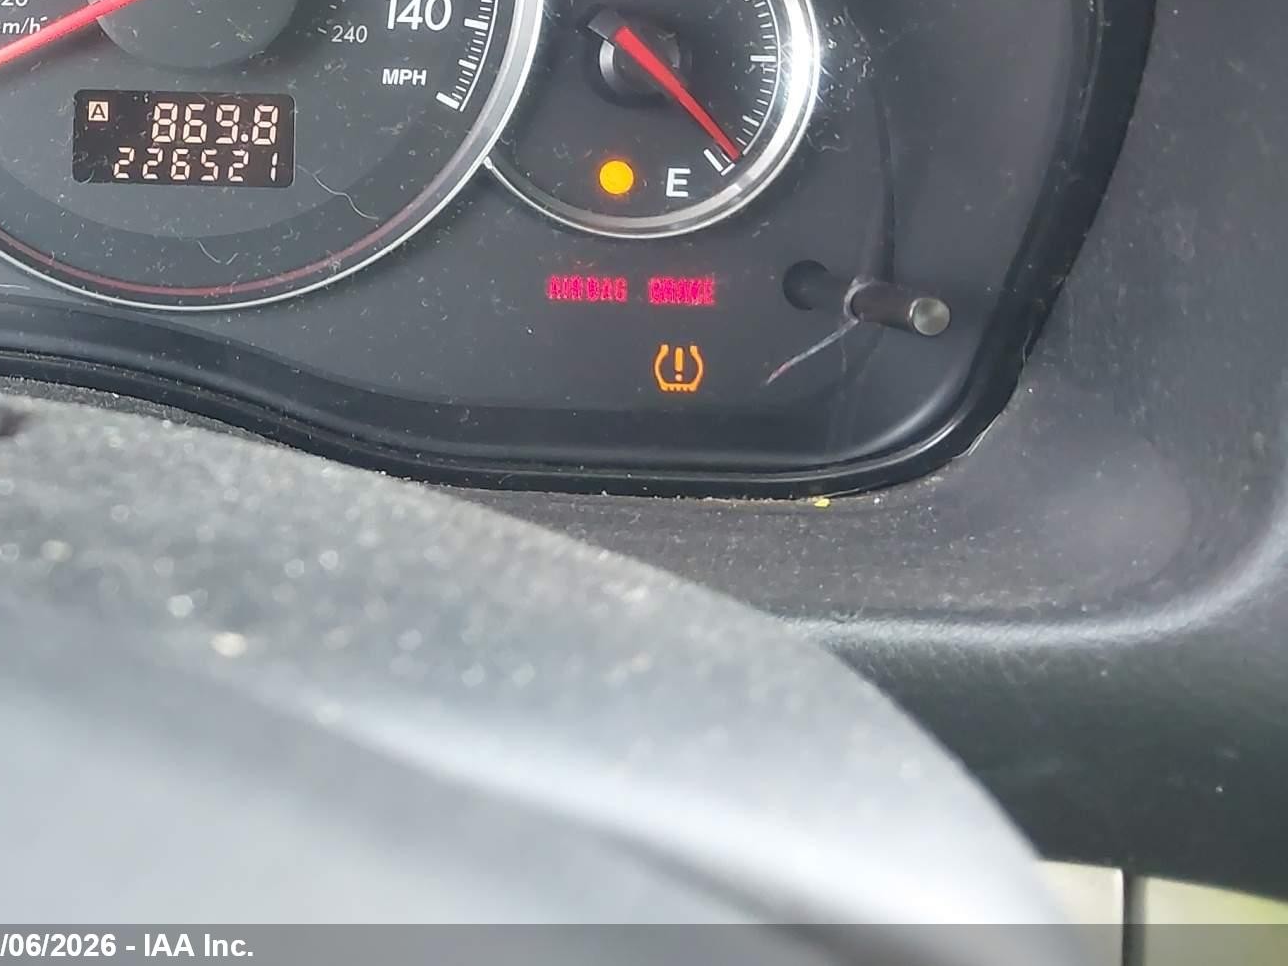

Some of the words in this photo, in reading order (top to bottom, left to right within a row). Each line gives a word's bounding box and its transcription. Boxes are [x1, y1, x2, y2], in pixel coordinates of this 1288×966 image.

[331, 25, 368, 44] 240
[382, 68, 427, 86] MPH
[151, 102, 279, 145] 869.8
[113, 146, 279, 182] 226521
[665, 167, 691, 198] E
